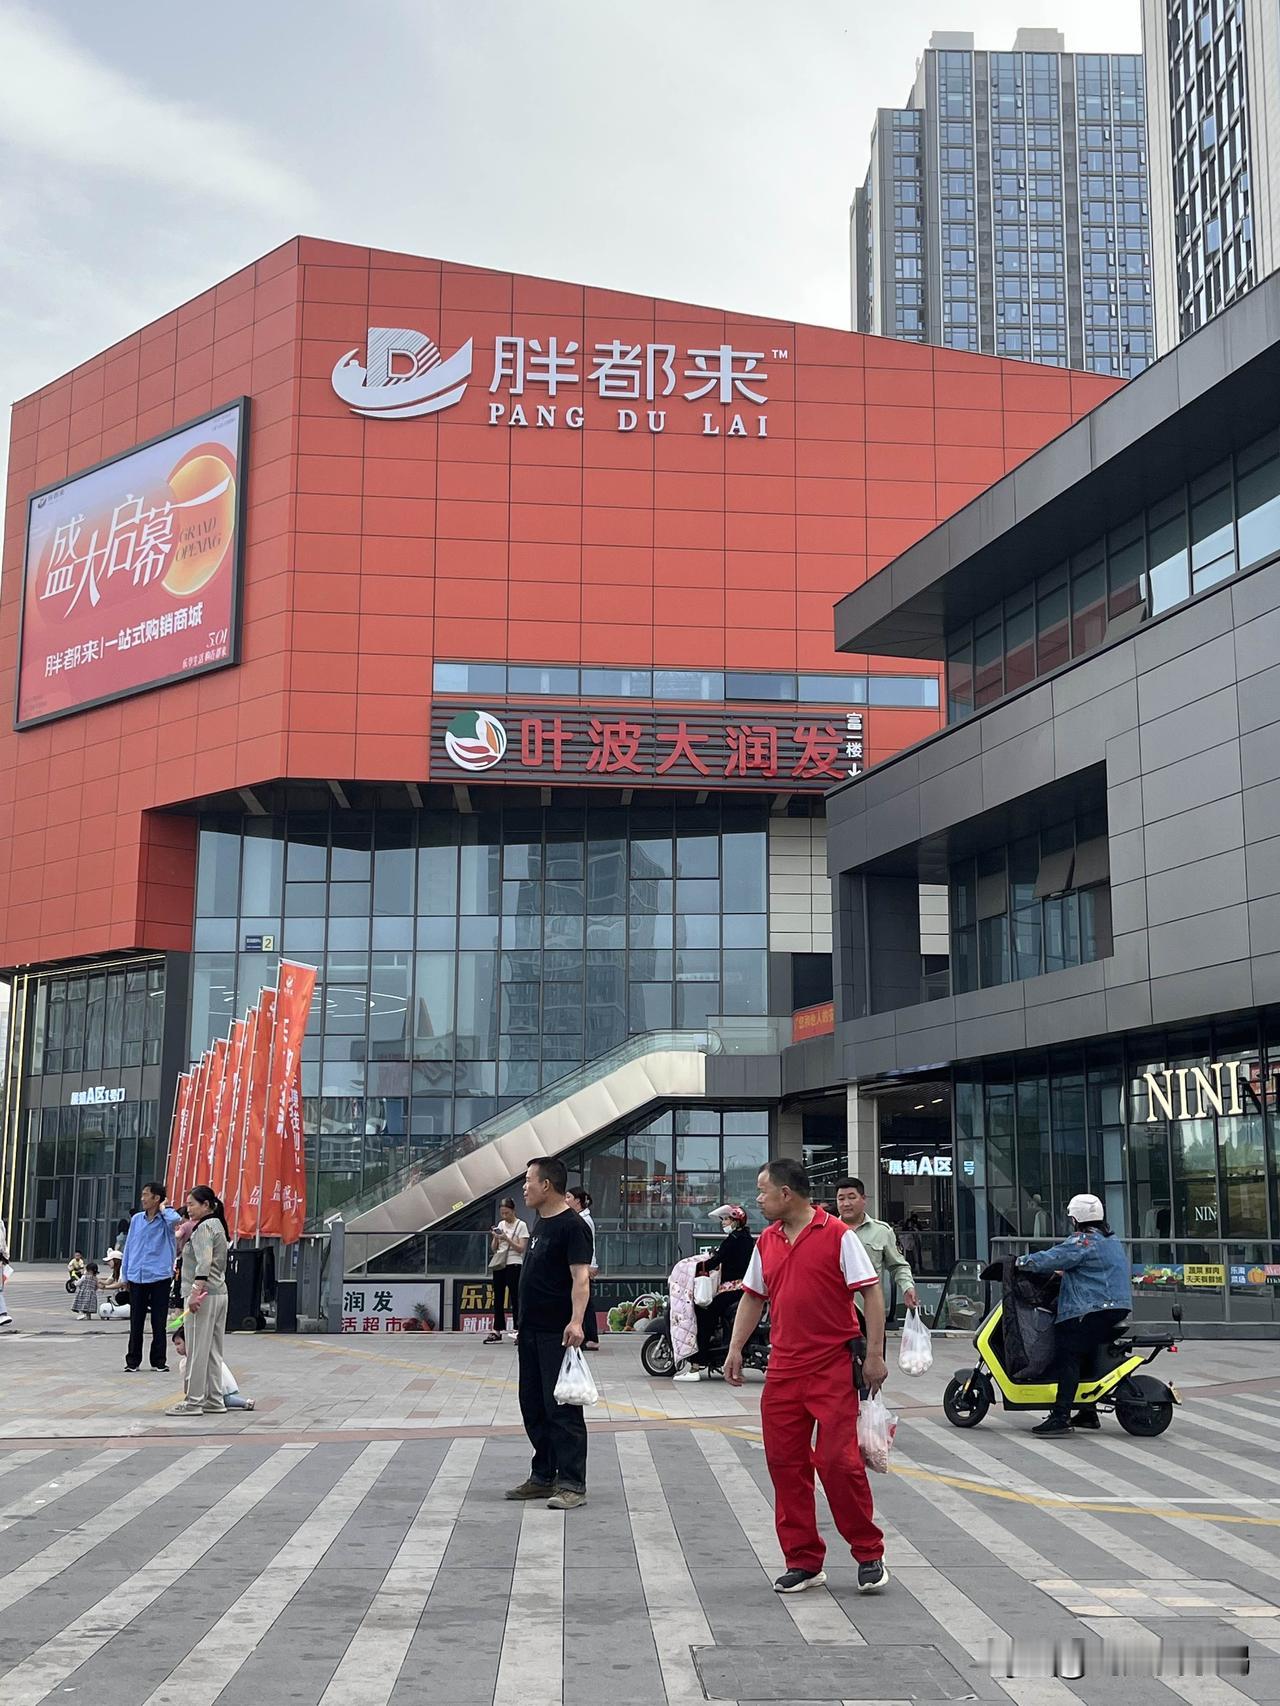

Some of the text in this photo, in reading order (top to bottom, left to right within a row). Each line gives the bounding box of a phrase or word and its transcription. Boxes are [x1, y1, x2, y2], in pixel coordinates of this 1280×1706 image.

[489, 335, 769, 404] 胖都来
[772, 349, 788, 359] TM
[488, 403, 768, 437] PANG DU LAI
[40, 491, 190, 618] 盛大启幕
[520, 717, 845, 779] 叶波大润发
[264, 938, 272, 949] 2
[343, 1290, 394, 1313] 润发
